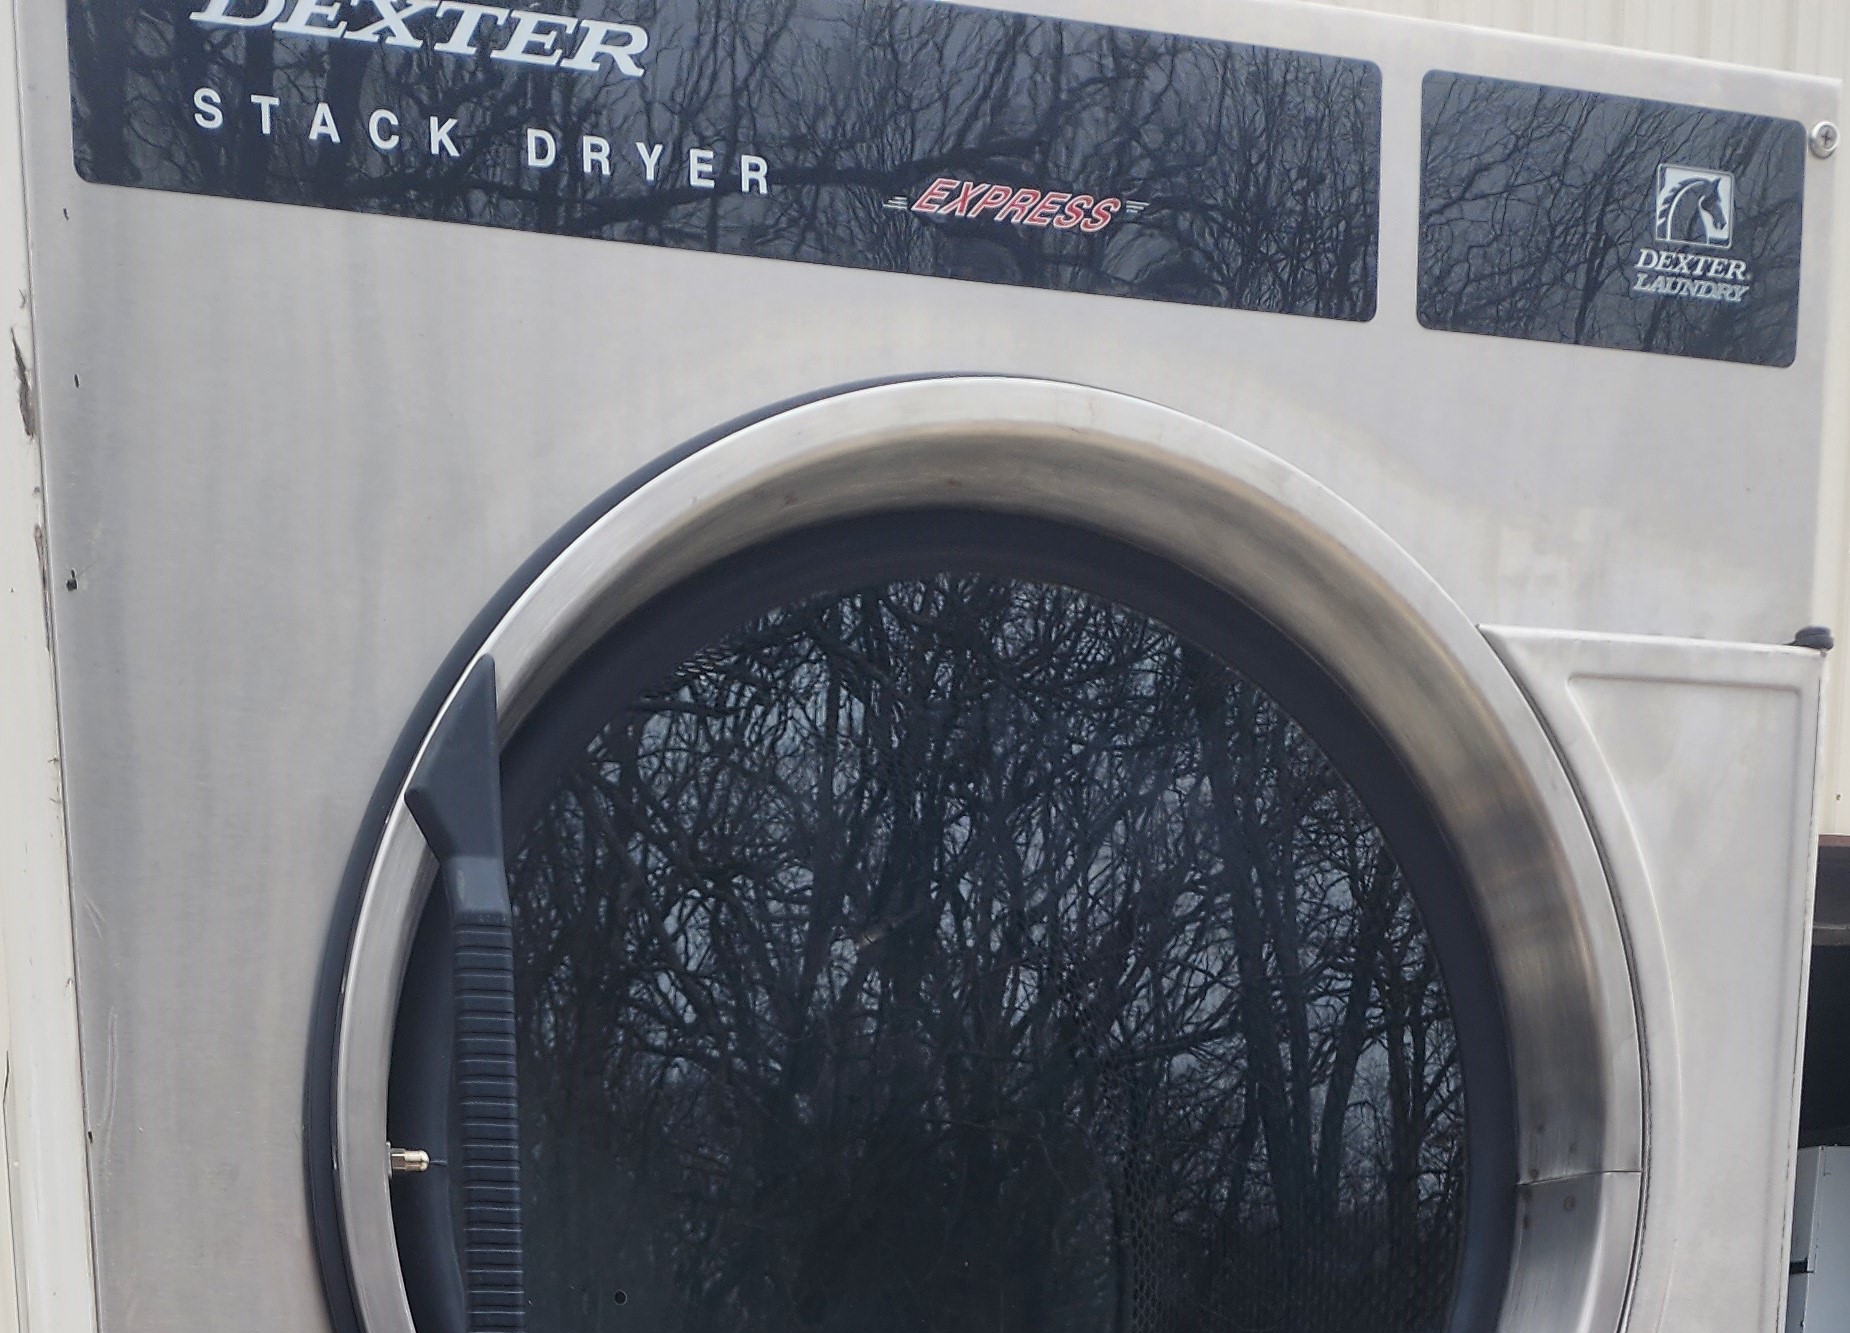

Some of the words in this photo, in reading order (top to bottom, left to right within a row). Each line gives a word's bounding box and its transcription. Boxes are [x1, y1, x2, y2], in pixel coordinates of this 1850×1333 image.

[193, 87, 461, 157] STACK
[527, 127, 768, 194] DRYER
[911, 178, 1121, 232] EXPRESS
[1634, 248, 1748, 280] DEXTER
[1633, 272, 1750, 302] LAUNDRY
